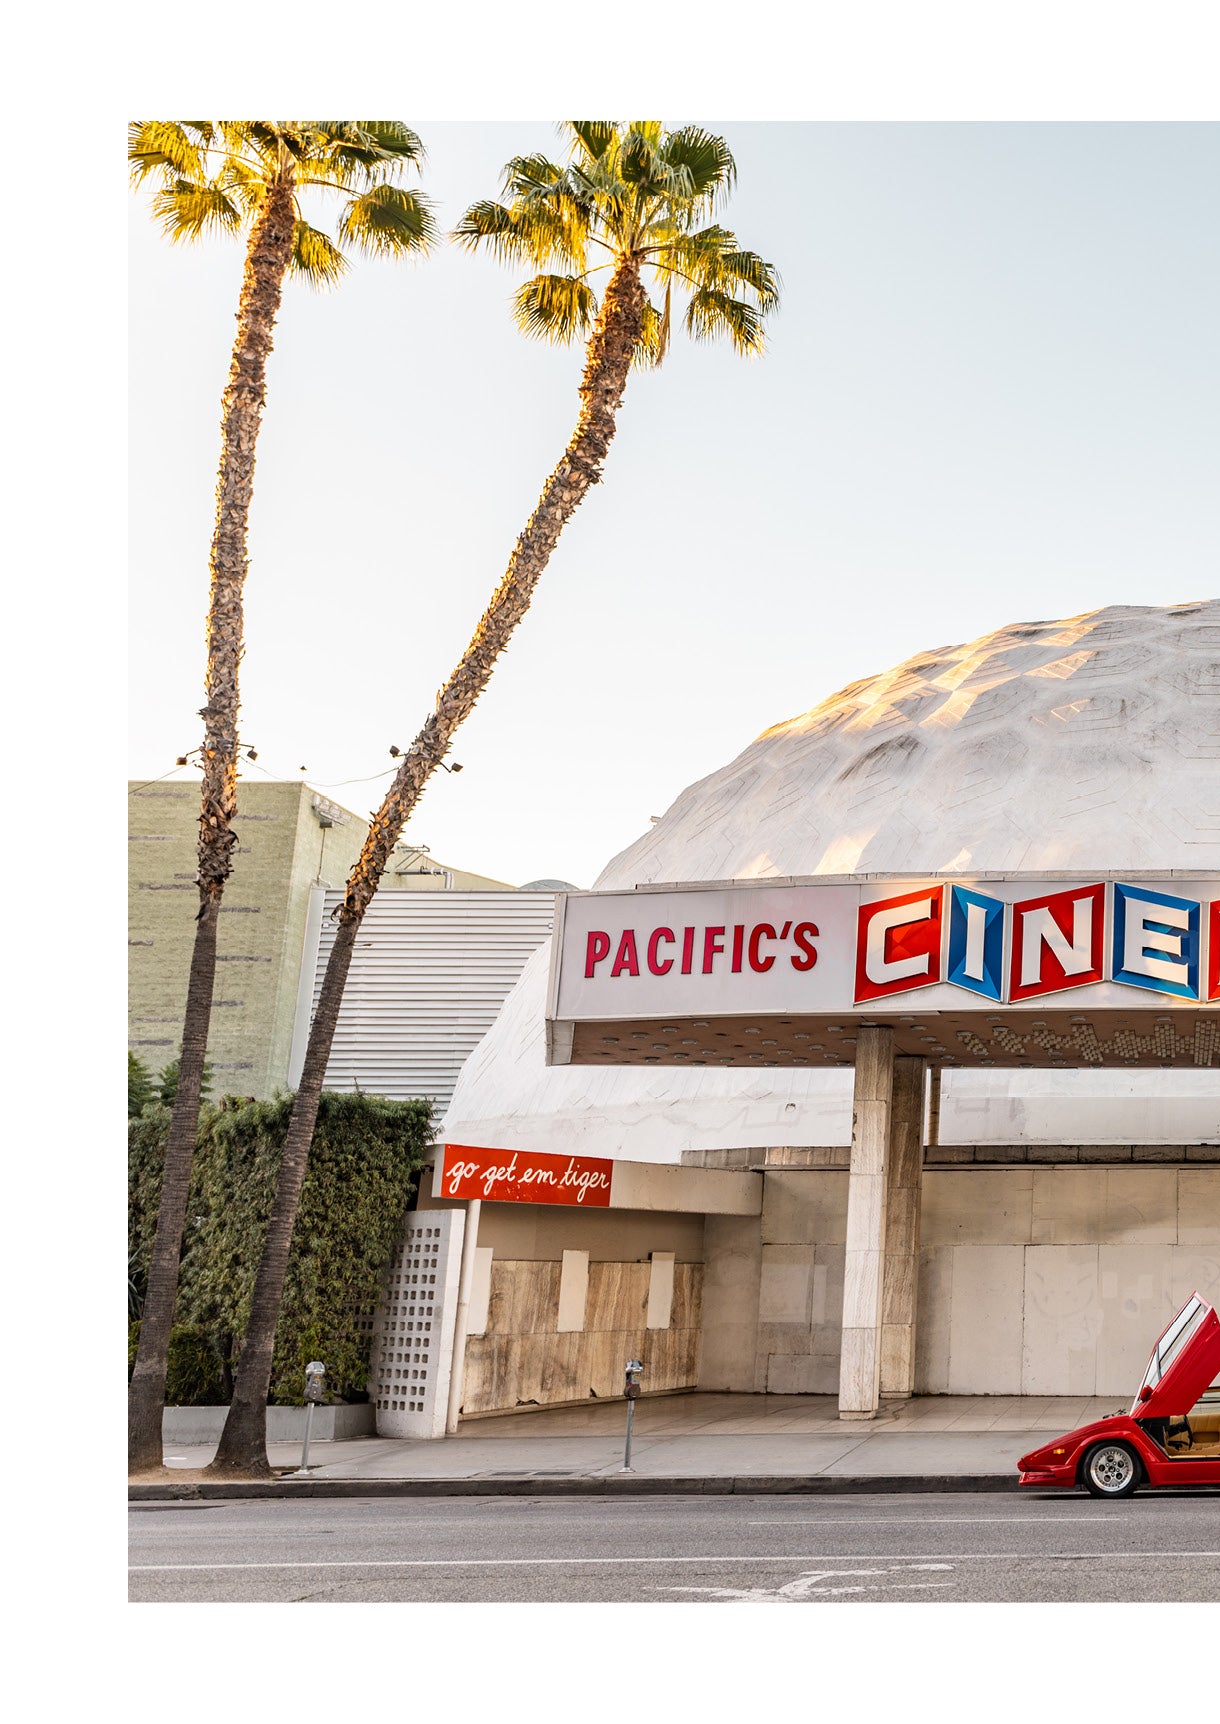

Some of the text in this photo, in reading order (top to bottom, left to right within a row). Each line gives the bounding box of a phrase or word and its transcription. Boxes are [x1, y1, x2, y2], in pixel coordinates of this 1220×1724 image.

[584, 921, 820, 978] PACIFIC'S
[446, 1152, 609, 1202] go get em tiger
